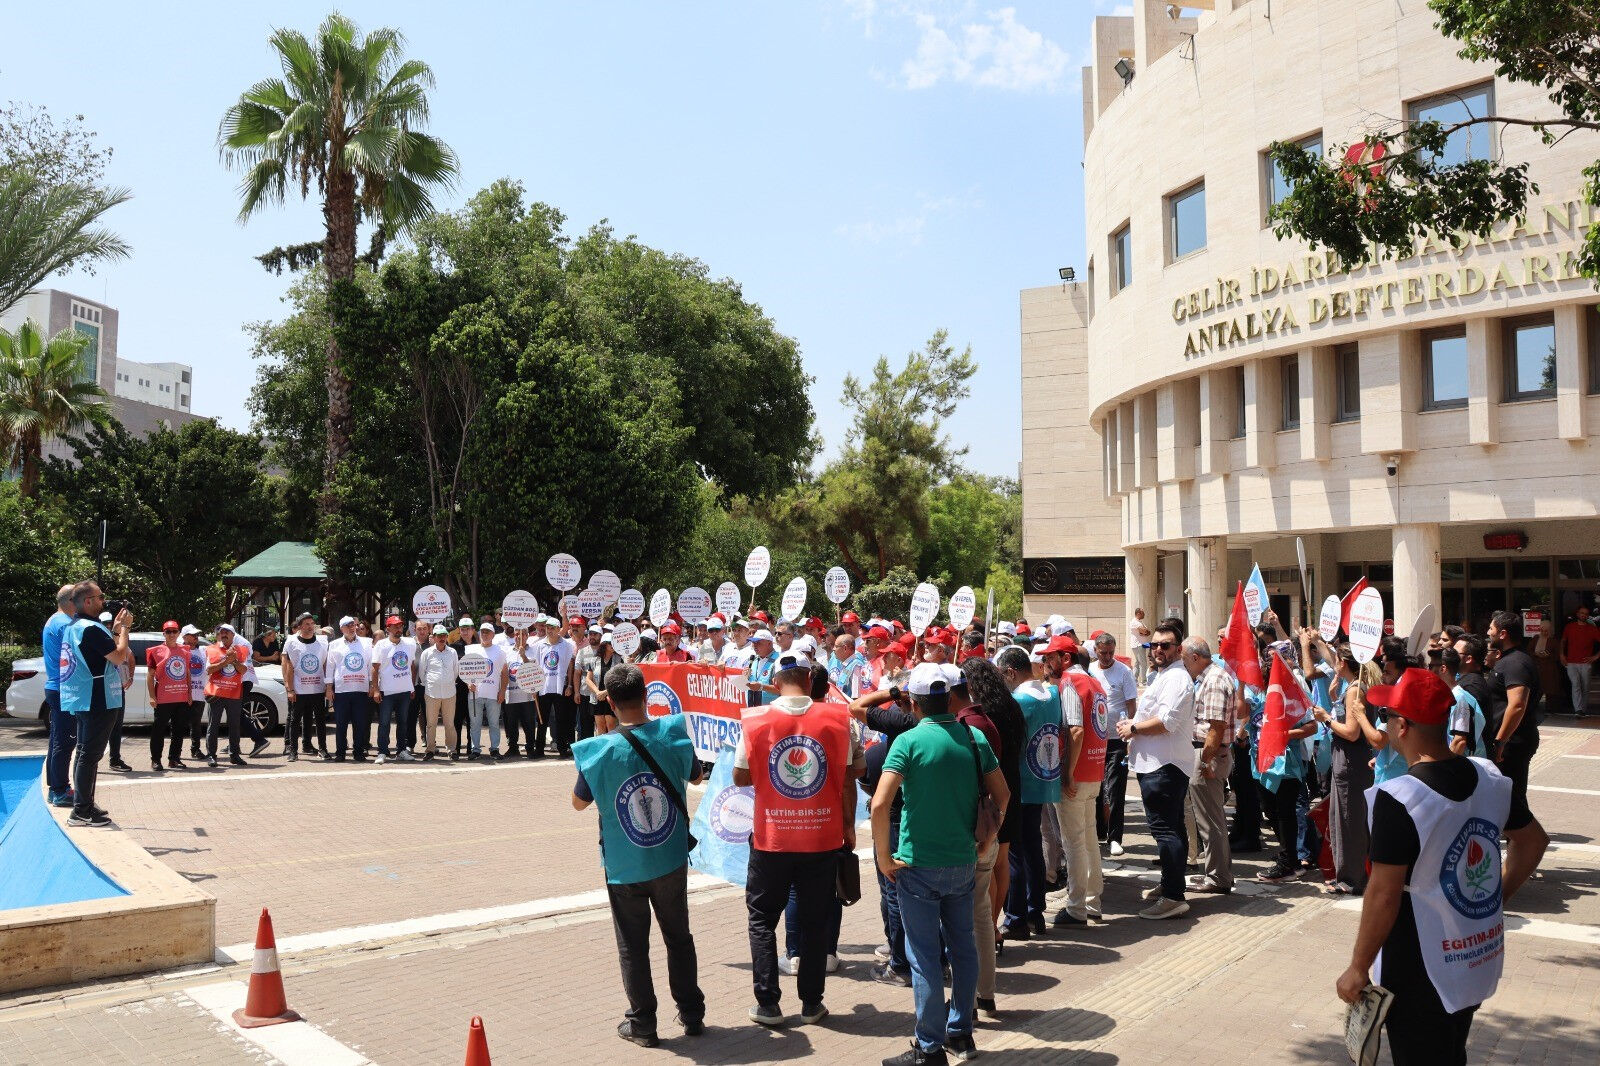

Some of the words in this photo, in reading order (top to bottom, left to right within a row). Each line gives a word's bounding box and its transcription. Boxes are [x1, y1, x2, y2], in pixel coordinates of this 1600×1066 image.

[1172, 278, 1243, 322] GELİR
[1184, 305, 1301, 357] ANTALYA
[687, 673, 717, 699] GELİRDE
